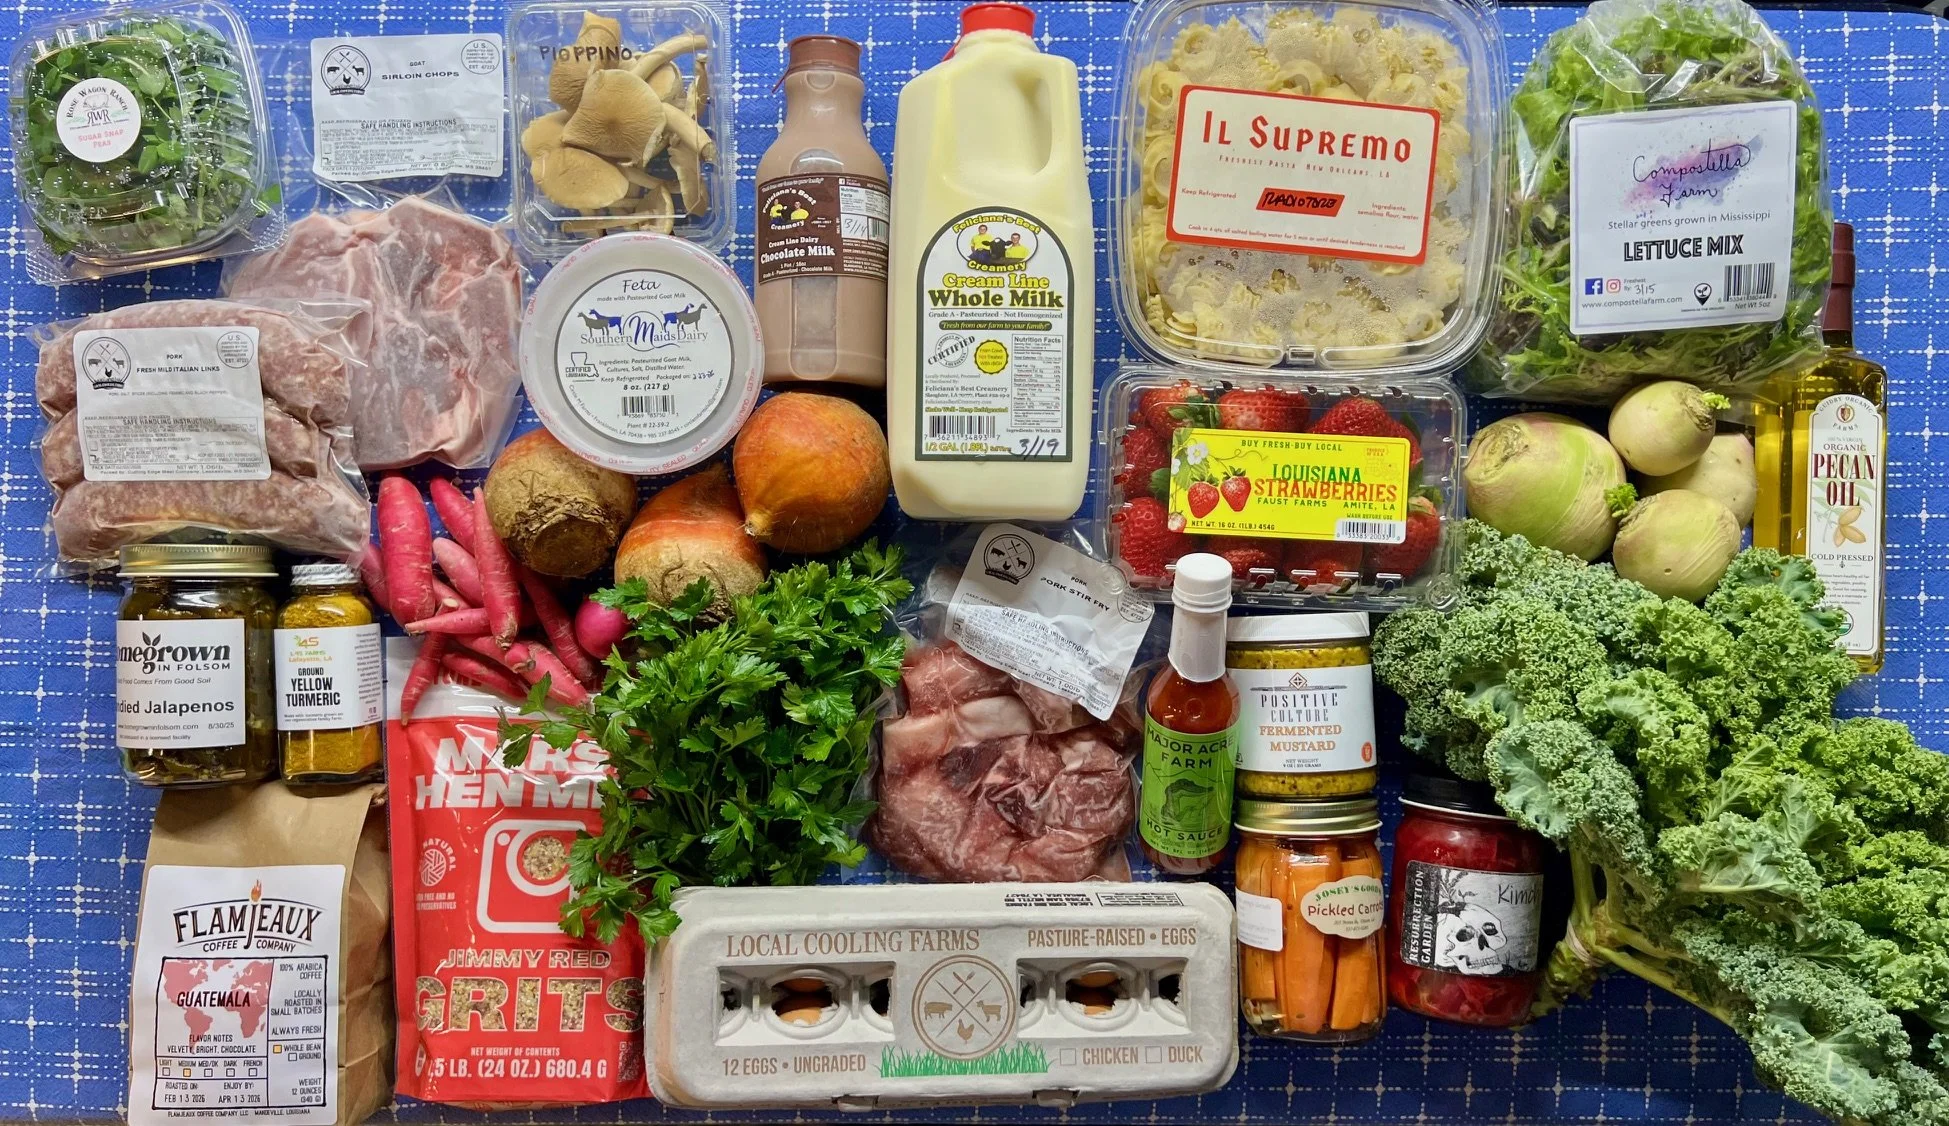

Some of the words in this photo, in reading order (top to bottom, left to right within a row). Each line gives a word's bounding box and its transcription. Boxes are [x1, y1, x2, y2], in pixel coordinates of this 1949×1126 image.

[539, 46, 633, 62] PIOPPINO
[66, 98, 78, 118] ROSE
[81, 86, 107, 98] WAGON
[110, 90, 128, 112] RANCH
[78, 132, 102, 142] SUGAR
[104, 129, 124, 138] SNAP
[1249, 115, 1411, 163] SUPREMO
[93, 140, 111, 148] PEAS
[1633, 138, 1750, 182] Compostella
[1380, 170, 1390, 178] LA
[798, 190, 816, 205] Best
[1659, 183, 1717, 208] Farm
[771, 220, 804, 230] Creamery
[844, 219, 868, 236] 3/14
[953, 215, 1013, 233] Feliciana's
[1015, 217, 1041, 234] Best
[1608, 221, 1638, 229] Stellar
[1641, 219, 1672, 229] greens
[1675, 217, 1706, 227] grown
[1720, 211, 1771, 221] Mississippi
[769, 238, 785, 248] Cream
[800, 236, 819, 244] Dairy
[1624, 237, 1701, 262] LETTUCE
[1707, 235, 1744, 256] MIX
[761, 247, 805, 264] Chocolate
[808, 246, 835, 256] Milk
[968, 261, 1026, 272] Creamery
[623, 279, 662, 293] Feta
[943, 273, 1005, 288] Cream
[1008, 273, 1049, 288] Line
[928, 290, 1003, 307] Whole
[1009, 290, 1064, 307] Milk
[1582, 296, 1683, 308] www.compostellafarm.com
[928, 335, 975, 365] CERTIFIED
[644, 383, 660, 391] (227
[663, 383, 669, 391] g)
[1018, 436, 1059, 460] 3/19
[1241, 440, 1259, 448] BUY
[1316, 443, 1342, 451] LOCAL
[1272, 463, 1362, 484] LOUISIANA
[1814, 454, 1875, 480] PECAN
[1254, 479, 1398, 503] STRAWBERRIES
[1826, 481, 1860, 506] OIL
[1343, 501, 1377, 510] AMITE,
[1383, 502, 1395, 510] LA
[1836, 554, 1873, 562] PRESSED
[1071, 577, 1087, 586] PORK
[1069, 589, 1091, 601] STIR
[1094, 600, 1110, 611] FRY
[118, 644, 230, 674] megrown
[298, 668, 324, 676] GROUND
[291, 678, 332, 691] YELLOW
[286, 692, 340, 707] TURMERIC
[1261, 693, 1338, 707] POSITIVE
[118, 701, 139, 714] died
[145, 701, 234, 716] Jalapenos
[1271, 709, 1329, 722] CULTURE
[1260, 725, 1342, 736] FERMENTED
[1148, 726, 1192, 754] MAJOR
[1270, 741, 1336, 752] MUSTARD
[1162, 752, 1212, 768] FARM
[416, 773, 524, 810] HEN
[1147, 818, 1170, 836] HOT
[1178, 826, 1222, 841] SAUCE
[423, 838, 456, 871] NATURAL
[1308, 903, 1354, 916] Pickled
[1410, 870, 1424, 962] RESURRECTION
[173, 903, 322, 949] FLAMJEAUX
[726, 933, 799, 957] LOCAL
[803, 931, 903, 955] COOLING
[909, 929, 980, 951] FARMS
[1027, 929, 1146, 948] PASTURE-RAISED
[1162, 928, 1196, 945] EGGS
[1421, 914, 1433, 964] GARDEN
[203, 940, 238, 952] COFFEE
[256, 940, 296, 953] COMPANY
[442, 948, 543, 969] JIMMY
[549, 949, 611, 969] RED
[297, 963, 323, 971] ARABICA
[300, 971, 322, 979] COFFEE
[177, 991, 250, 1007] GUATEMALA
[294, 990, 321, 998] LOCALLY
[284, 999, 313, 1007] ROASTED
[315, 998, 322, 1006] IN
[415, 976, 645, 1033] GRITS
[271, 1007, 291, 1016] SMALL
[294, 1006, 322, 1015] BATCHES
[272, 1027, 299, 1035] ALWAYS
[301, 1026, 321, 1034] FRESH
[221, 1045, 256, 1054] CHOCOLATE
[1082, 1047, 1139, 1065] CHICKEN
[1168, 1046, 1203, 1064] DUCK
[450, 1059, 472, 1078] LB.
[478, 1059, 505, 1078] (24
[511, 1059, 540, 1078] OZ.)
[546, 1059, 594, 1078] 680.4
[597, 1059, 607, 1078] G
[723, 1058, 739, 1076] 12
[743, 1057, 777, 1074] EGGS
[794, 1054, 866, 1073] UNGRADED
